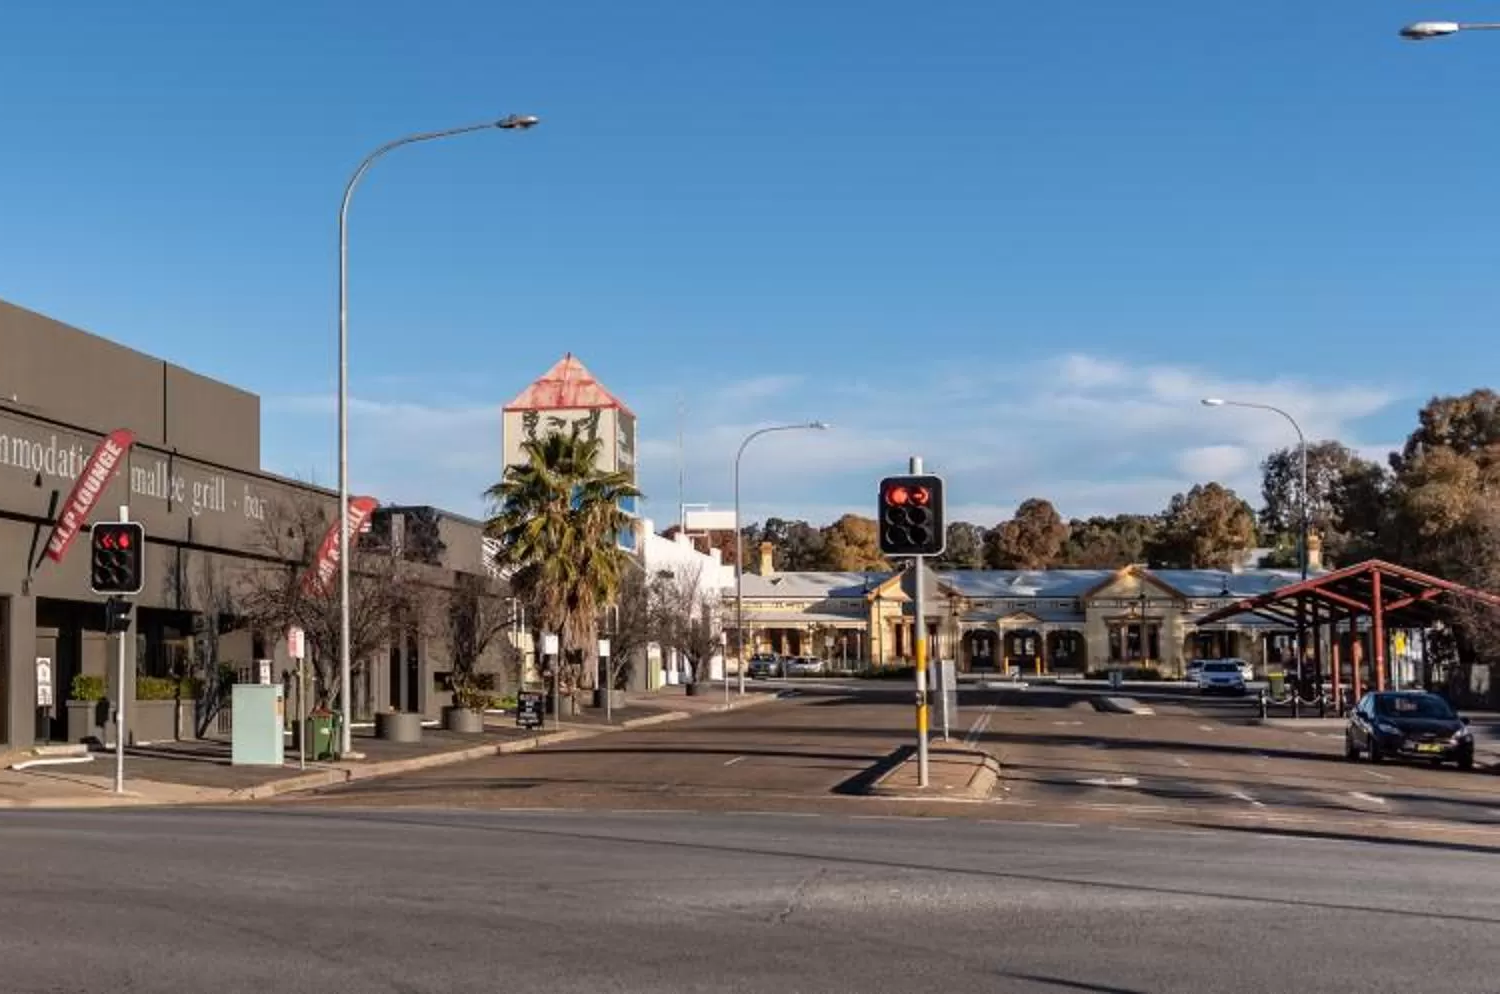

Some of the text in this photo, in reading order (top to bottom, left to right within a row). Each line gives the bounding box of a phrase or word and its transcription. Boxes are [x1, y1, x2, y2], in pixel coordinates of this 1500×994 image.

[77, 440, 122, 514] LOUNGE
[131, 461, 185, 502] mallee
[191, 475, 226, 517] grill
[244, 484, 268, 521] bar
